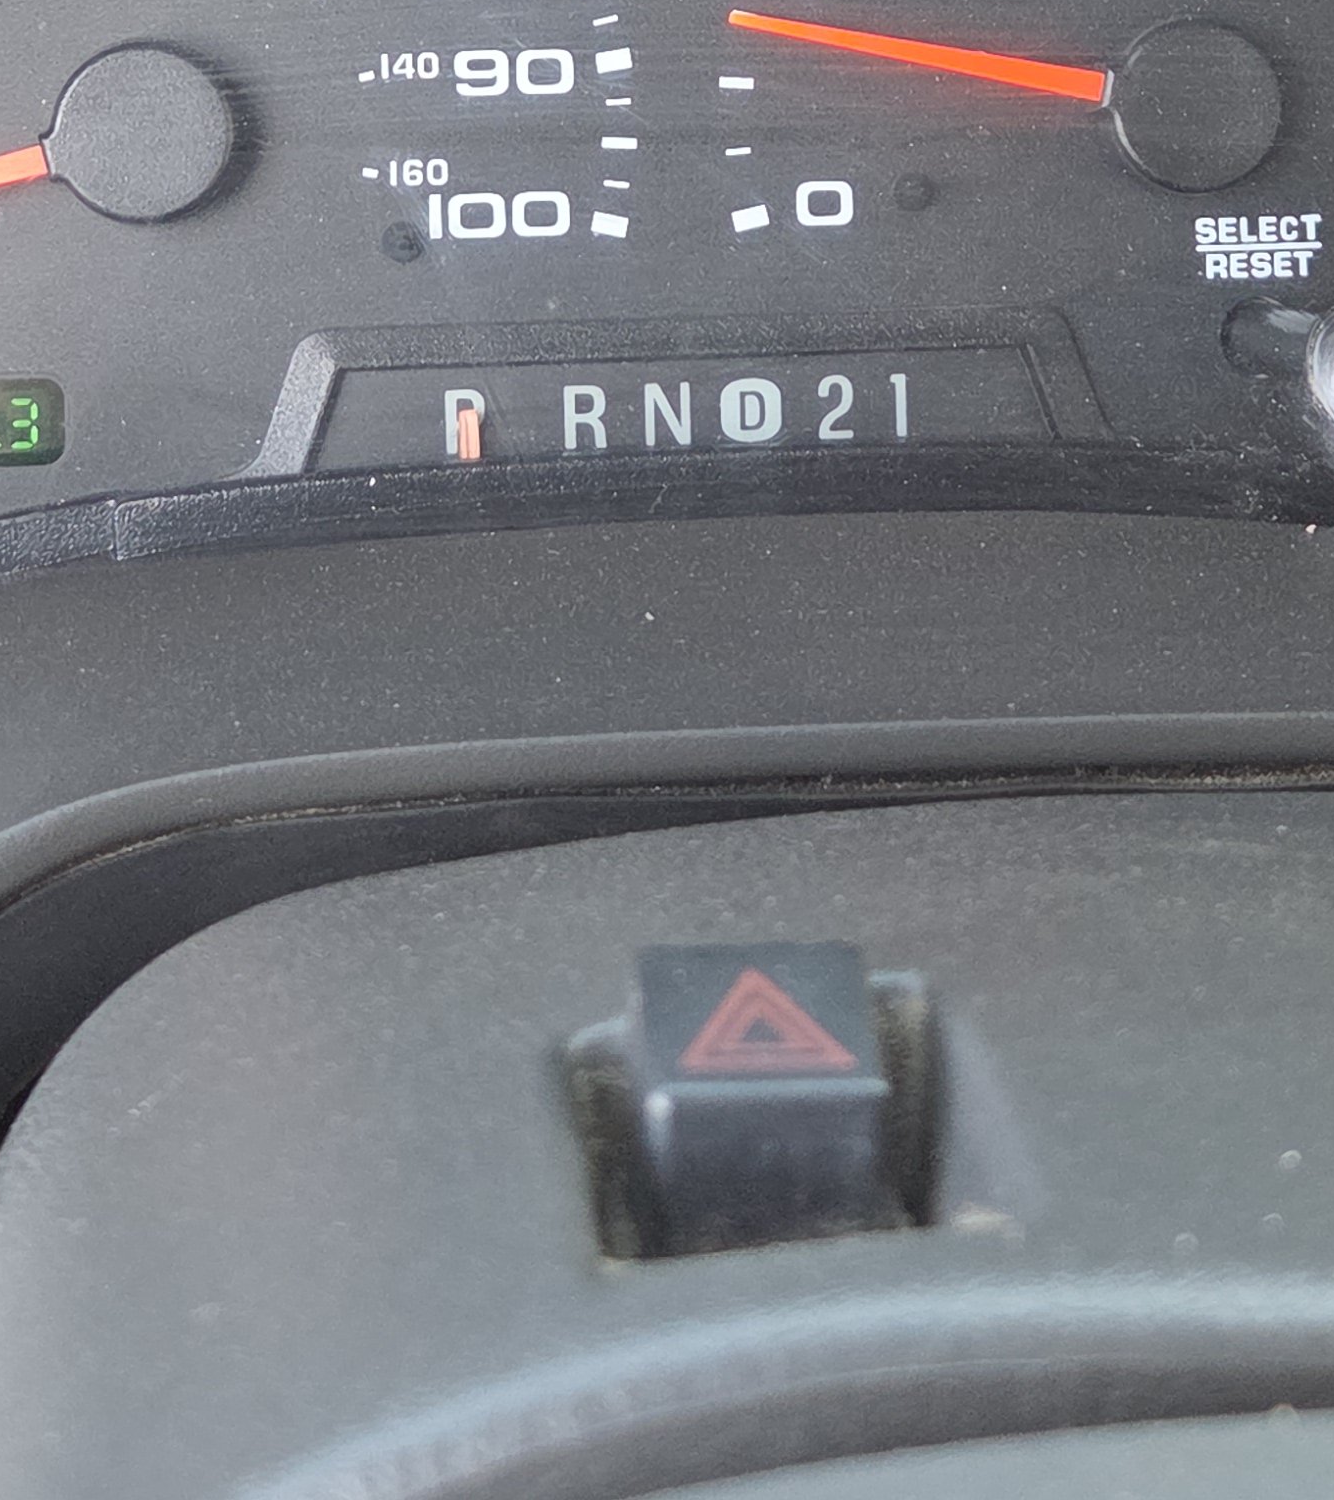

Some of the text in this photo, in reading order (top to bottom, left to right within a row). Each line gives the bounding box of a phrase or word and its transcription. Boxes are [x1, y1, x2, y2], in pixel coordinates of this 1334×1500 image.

[381, 52, 439, 79] 140
[454, 49, 574, 96] 90
[390, 159, 448, 186] 160
[429, 191, 570, 239] 100
[796, 181, 853, 226] 0
[1195, 214, 1322, 244] SELECT
[1205, 250, 1313, 279] RESET
[445, 389, 485, 455] P
[564, 385, 607, 449] R
[645, 382, 691, 446] N
[818, 375, 853, 439] 2
[890, 374, 907, 436] 1
